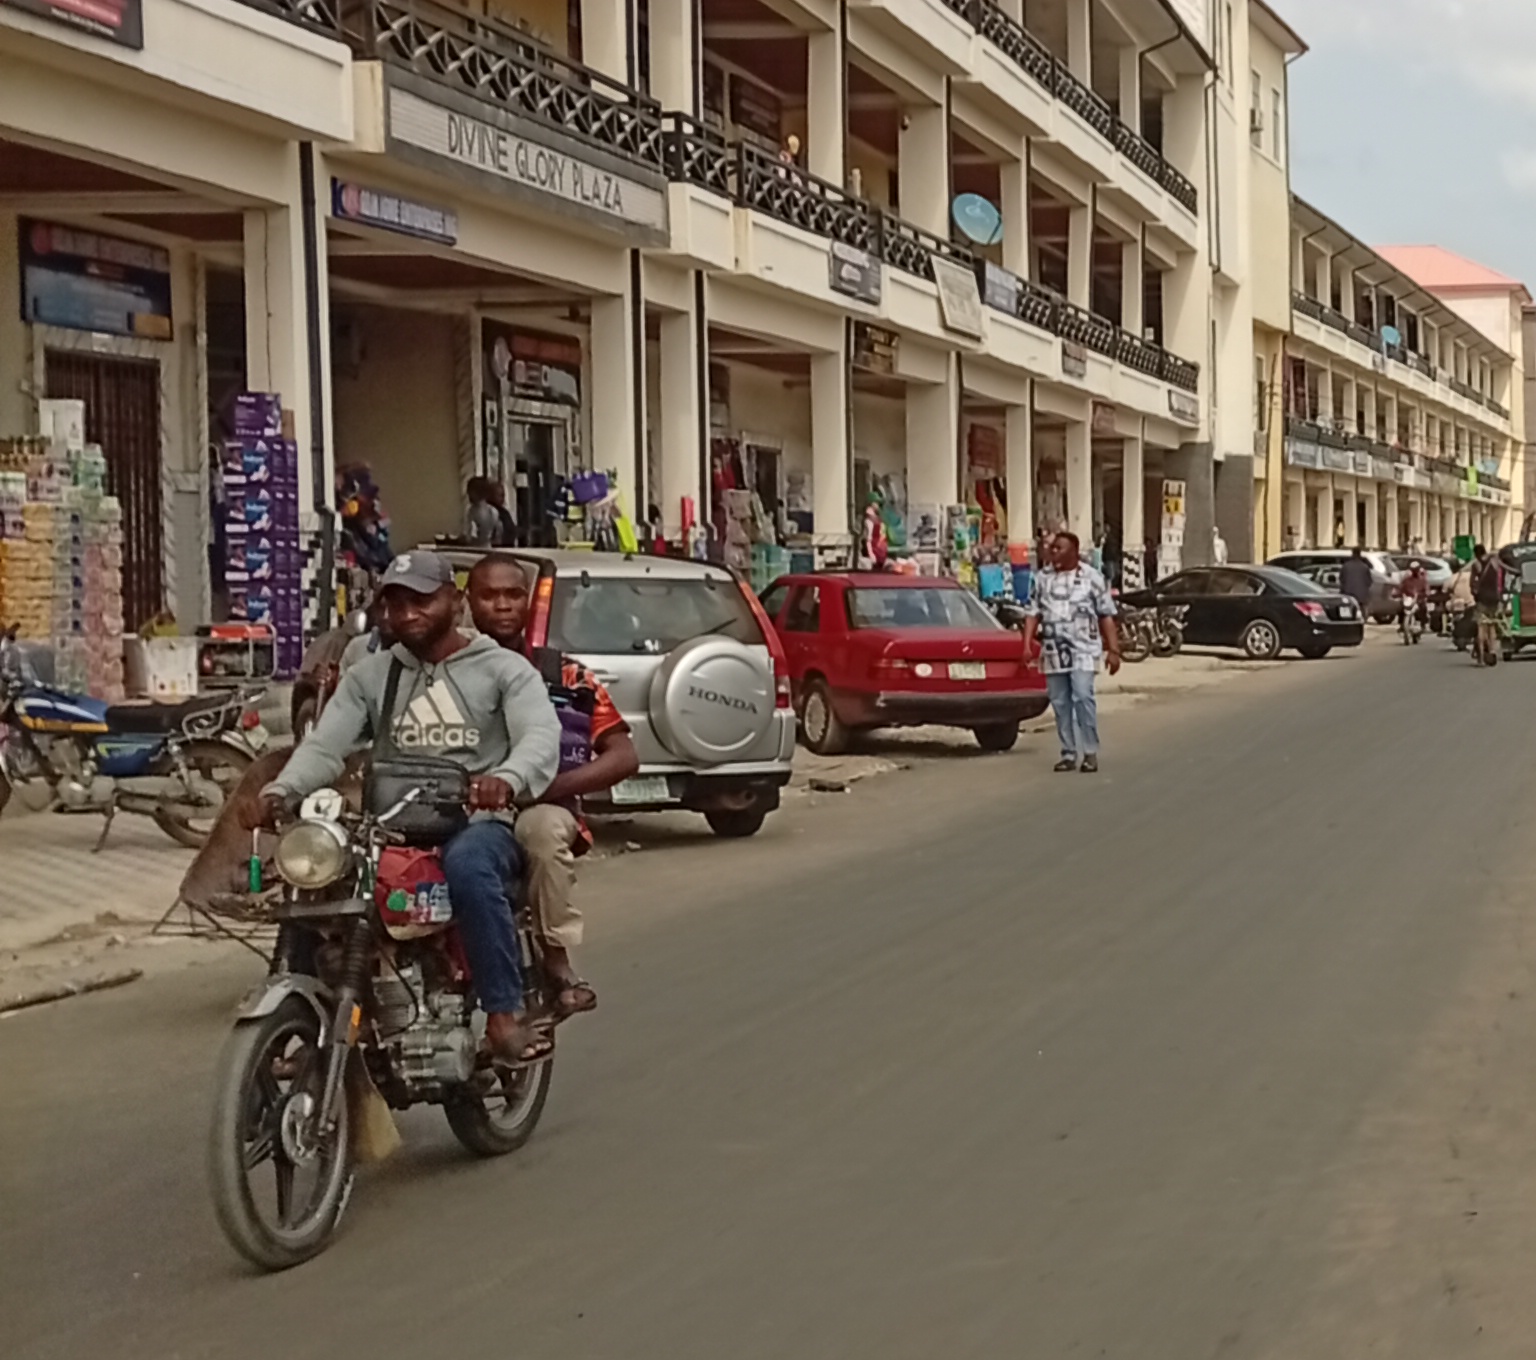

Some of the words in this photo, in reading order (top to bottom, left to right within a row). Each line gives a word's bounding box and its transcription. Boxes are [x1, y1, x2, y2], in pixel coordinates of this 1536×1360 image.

[448, 113, 509, 172] DIVINE
[515, 141, 565, 191] GLORY
[572, 162, 624, 214] PLAZA
[689, 686, 758, 715] HONDA
